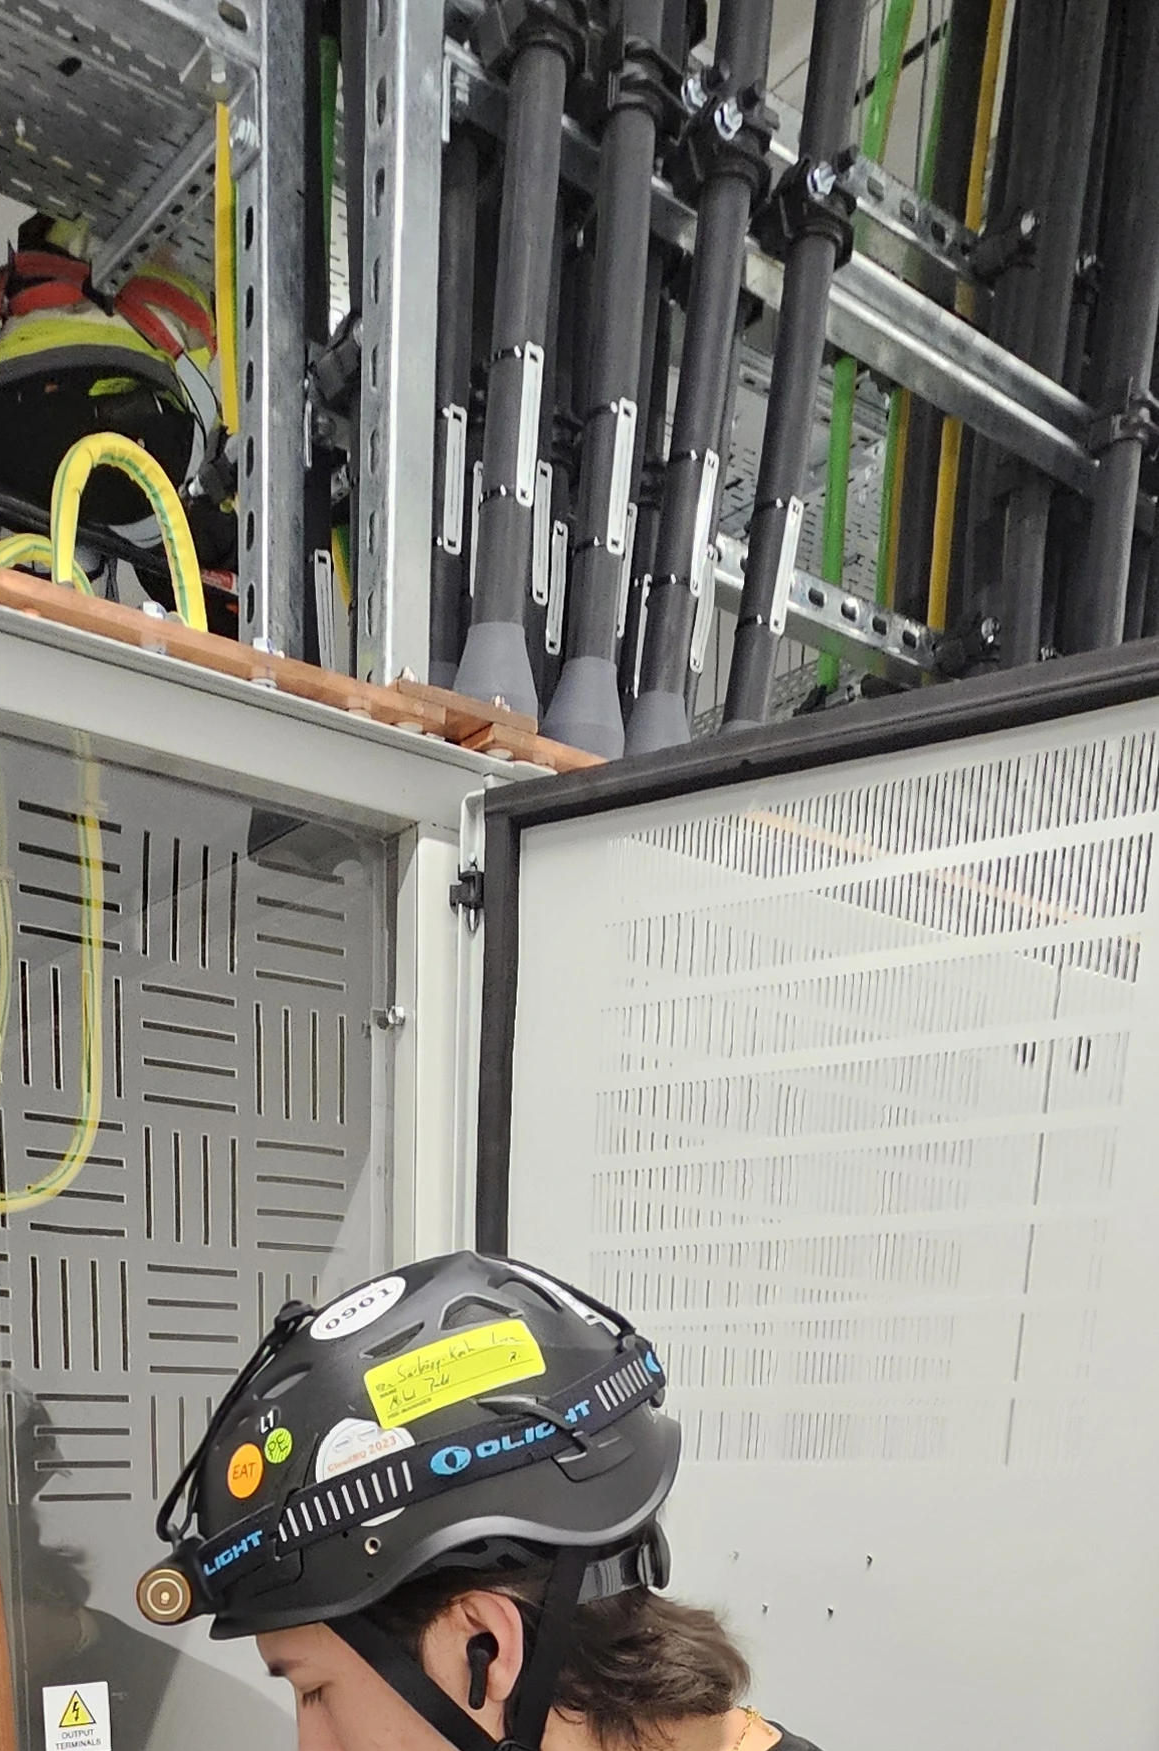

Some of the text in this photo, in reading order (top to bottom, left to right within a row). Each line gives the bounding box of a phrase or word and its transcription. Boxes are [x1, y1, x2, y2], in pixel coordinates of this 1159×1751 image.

[259, 1409, 275, 1435] L1
[368, 1435, 398, 1454] 2023
[231, 1461, 258, 1481] EAT
[61, 1728, 95, 1740] OUTPUT
[55, 1738, 102, 1750] TERMINALS
